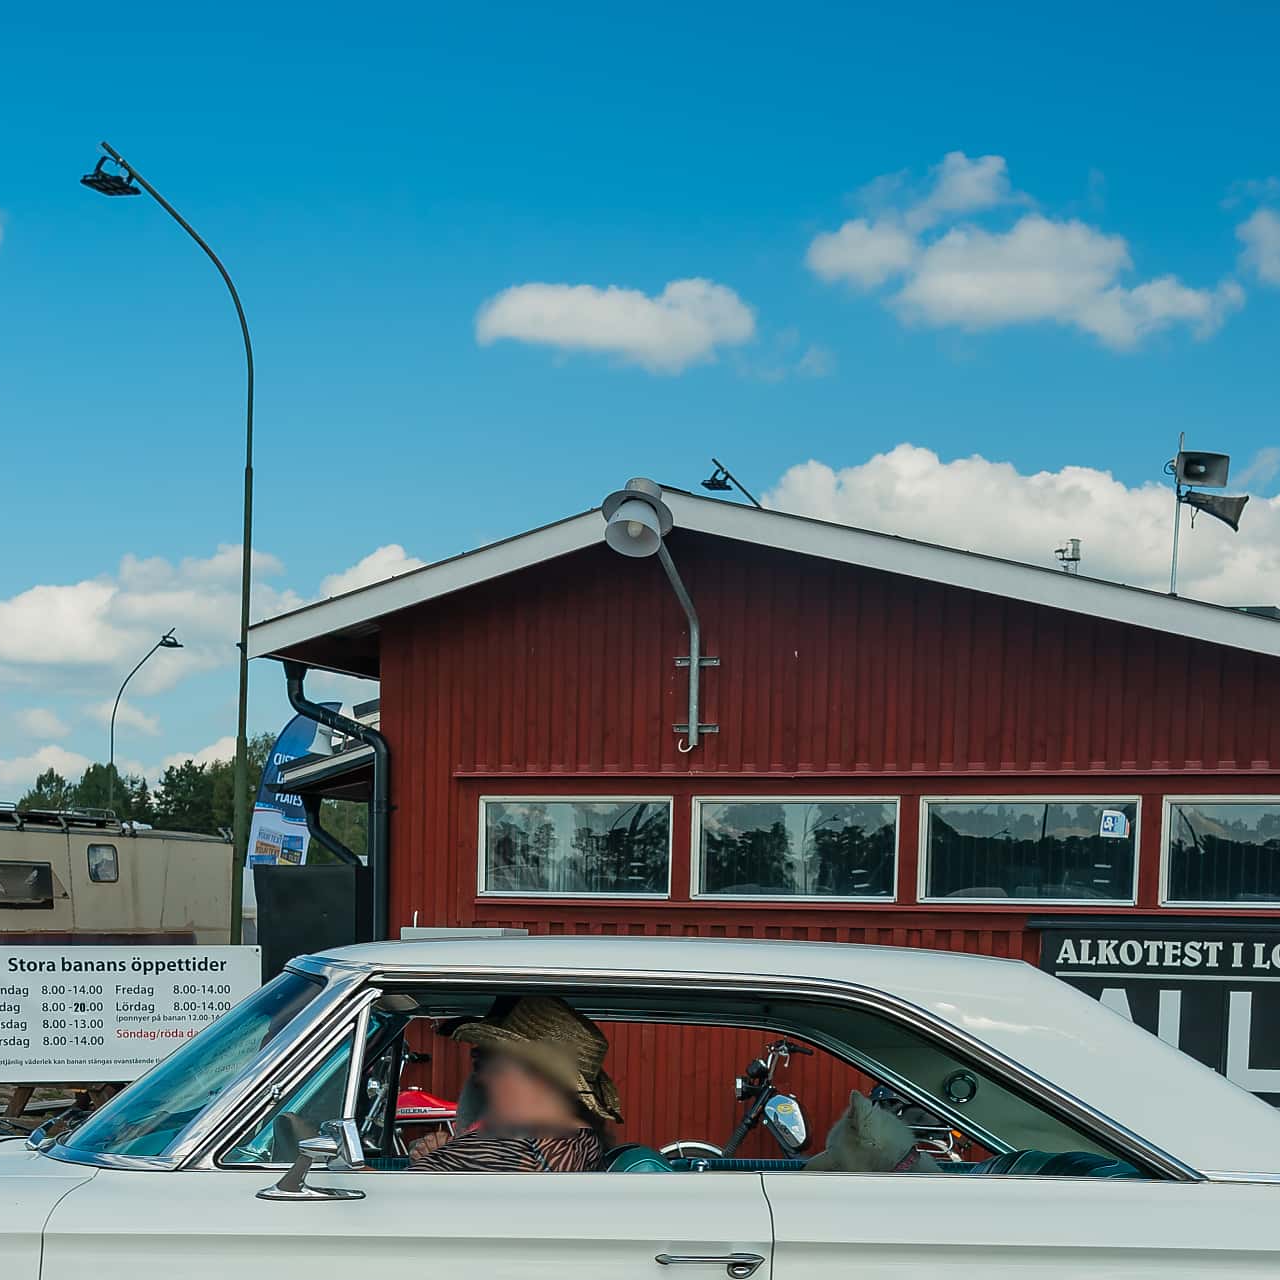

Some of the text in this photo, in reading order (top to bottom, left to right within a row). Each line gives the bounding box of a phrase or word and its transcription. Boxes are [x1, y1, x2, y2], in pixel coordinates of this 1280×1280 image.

[1055, 938, 1223, 967] ALKOTEST
[1231, 942, 1245, 967] I
[8, 956, 227, 975] Stora banans öppettider
[41, 985, 65, 995] 8.00
[68, 985, 103, 995] -14.00
[115, 984, 231, 996] Fredag 8.00-14.00
[42, 1002, 66, 1012] 8.00
[116, 1001, 231, 1013] Lördag 8.00-14.00
[116, 1014, 150, 1023] (ponnyer
[152, 1014, 161, 1022] på
[42, 1019, 66, 1029] 8.00
[116, 1028, 184, 1040] Söndag/röda
[43, 1037, 67, 1046] 8.00
[88, 1058, 112, 1066] stängas
